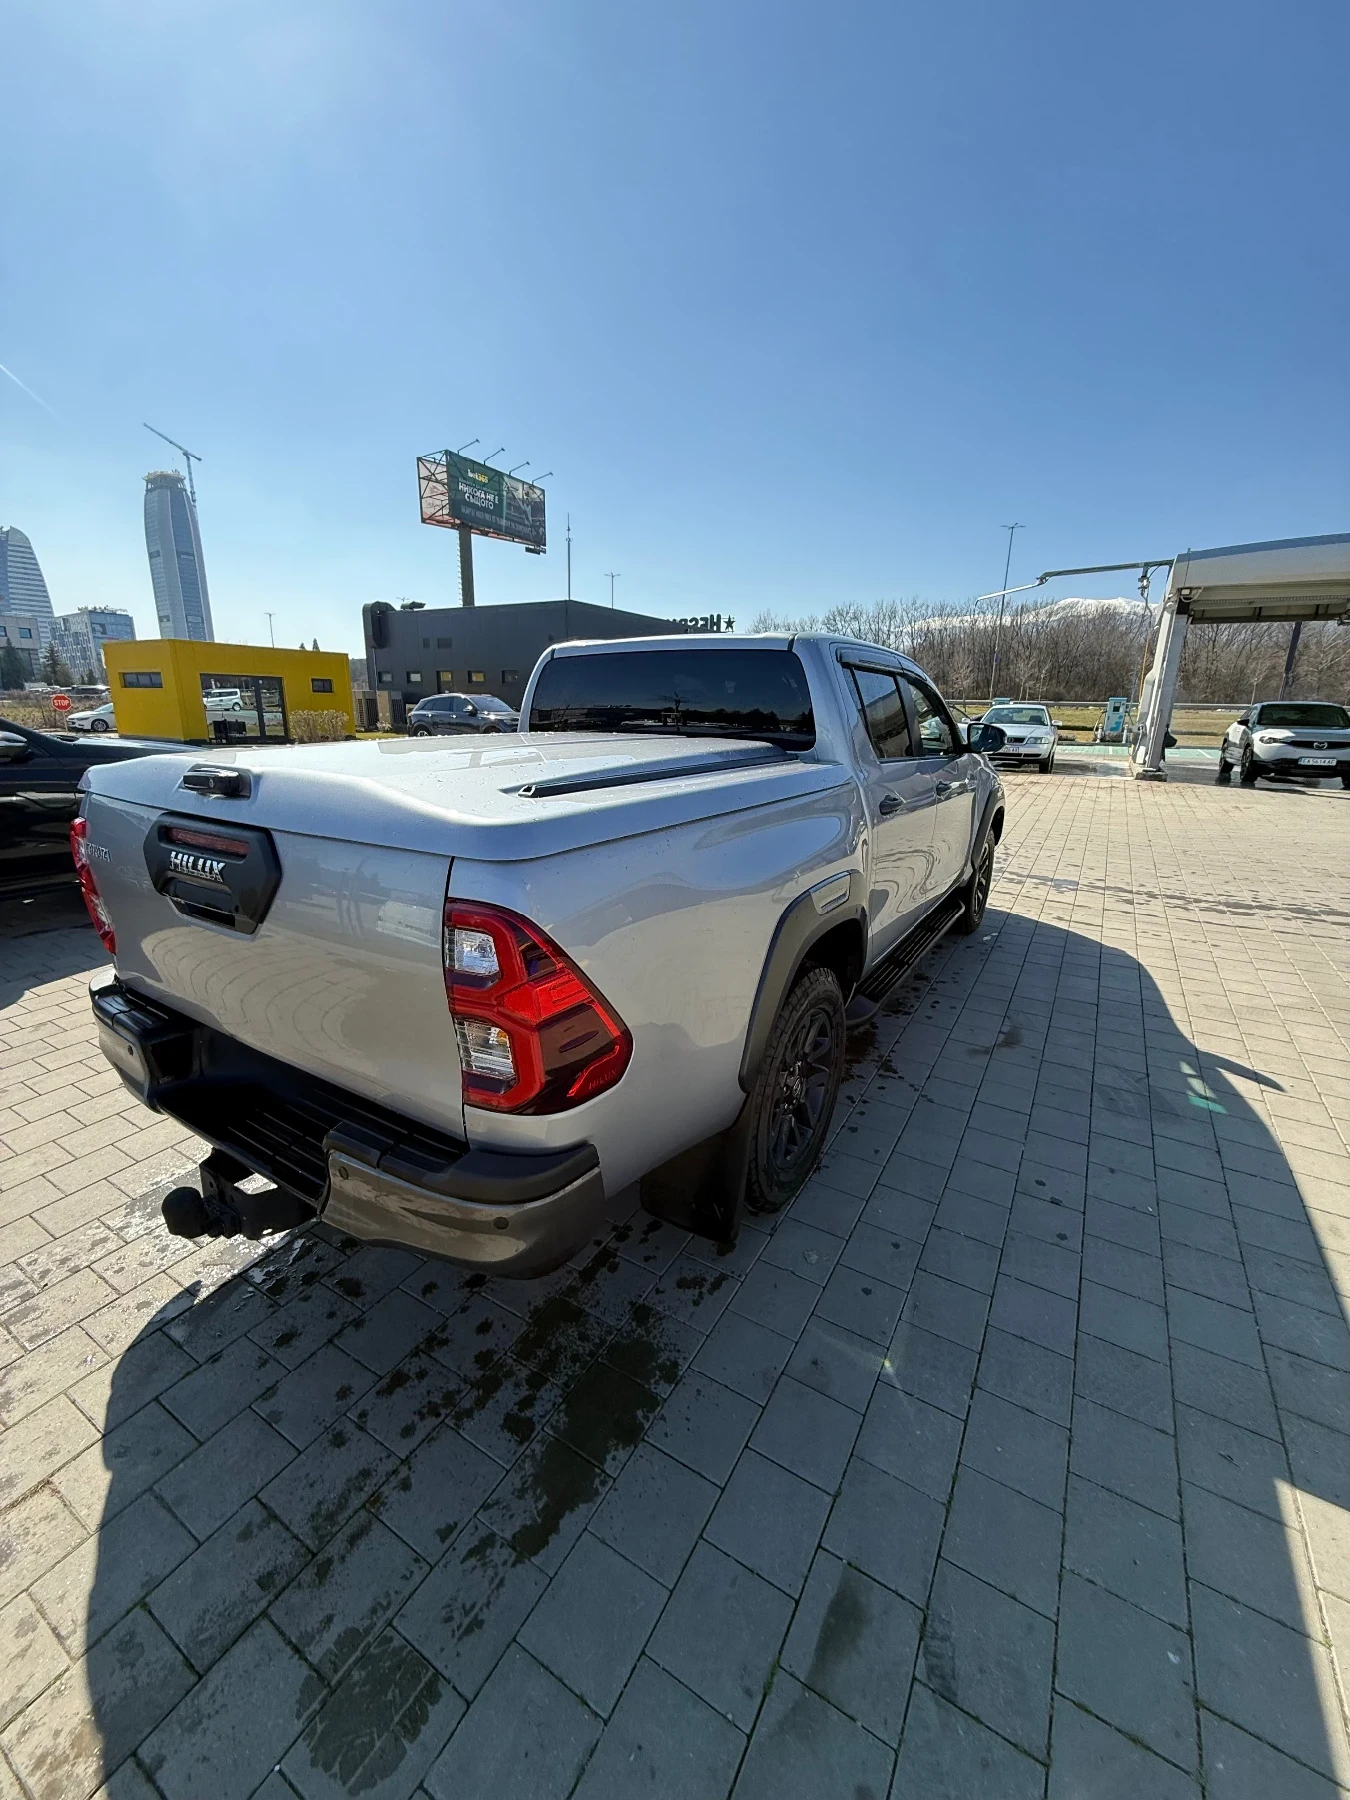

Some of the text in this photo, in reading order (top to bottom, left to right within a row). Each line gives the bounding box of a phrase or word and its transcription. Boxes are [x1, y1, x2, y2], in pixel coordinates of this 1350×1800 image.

[467, 468, 489, 484] bet365
[53, 699, 70, 707] STOP
[169, 851, 226, 883] HILUX
